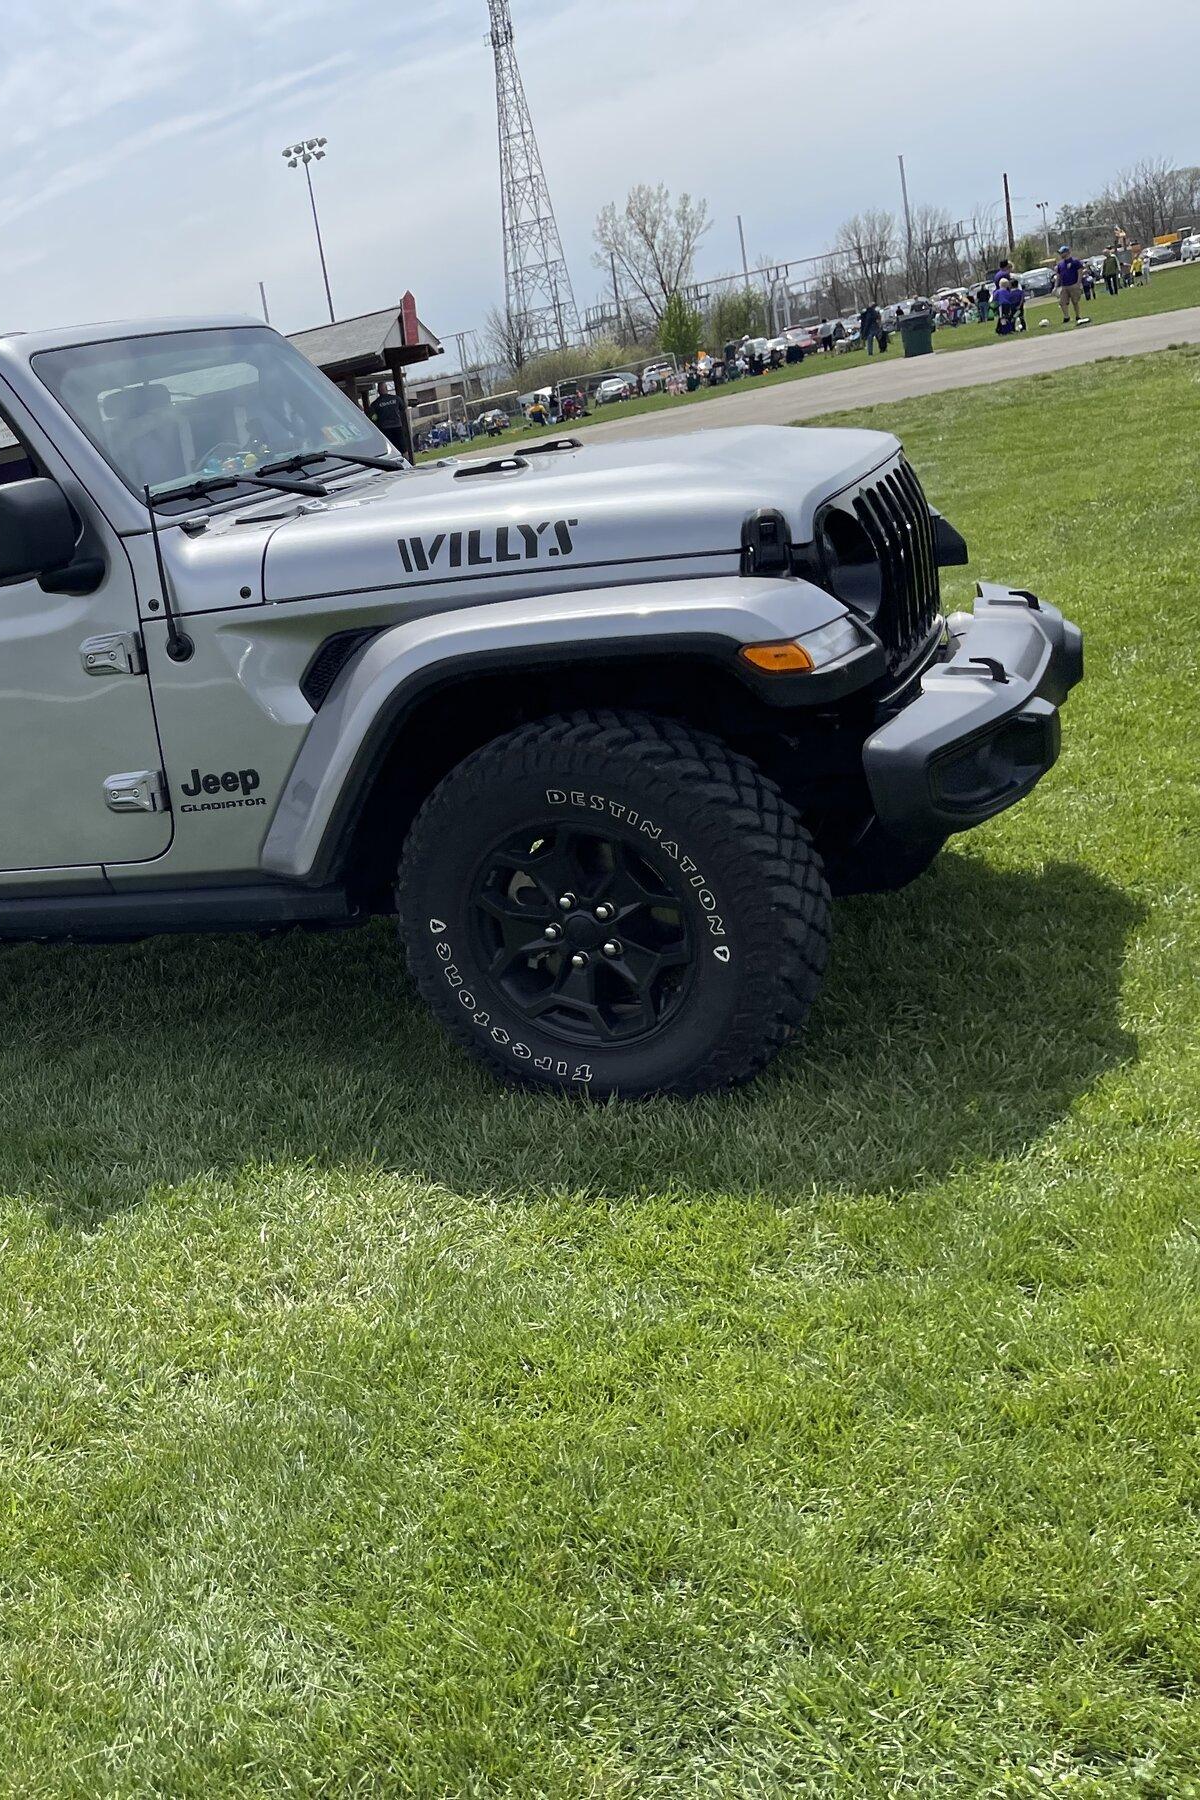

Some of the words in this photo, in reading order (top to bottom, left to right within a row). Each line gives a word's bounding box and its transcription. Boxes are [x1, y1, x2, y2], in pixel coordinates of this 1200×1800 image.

[397, 519, 578, 573] WILLYS
[181, 769, 260, 796] Jeep
[181, 797, 267, 813] GLADIATOR
[546, 789, 726, 936] DESTINATION
